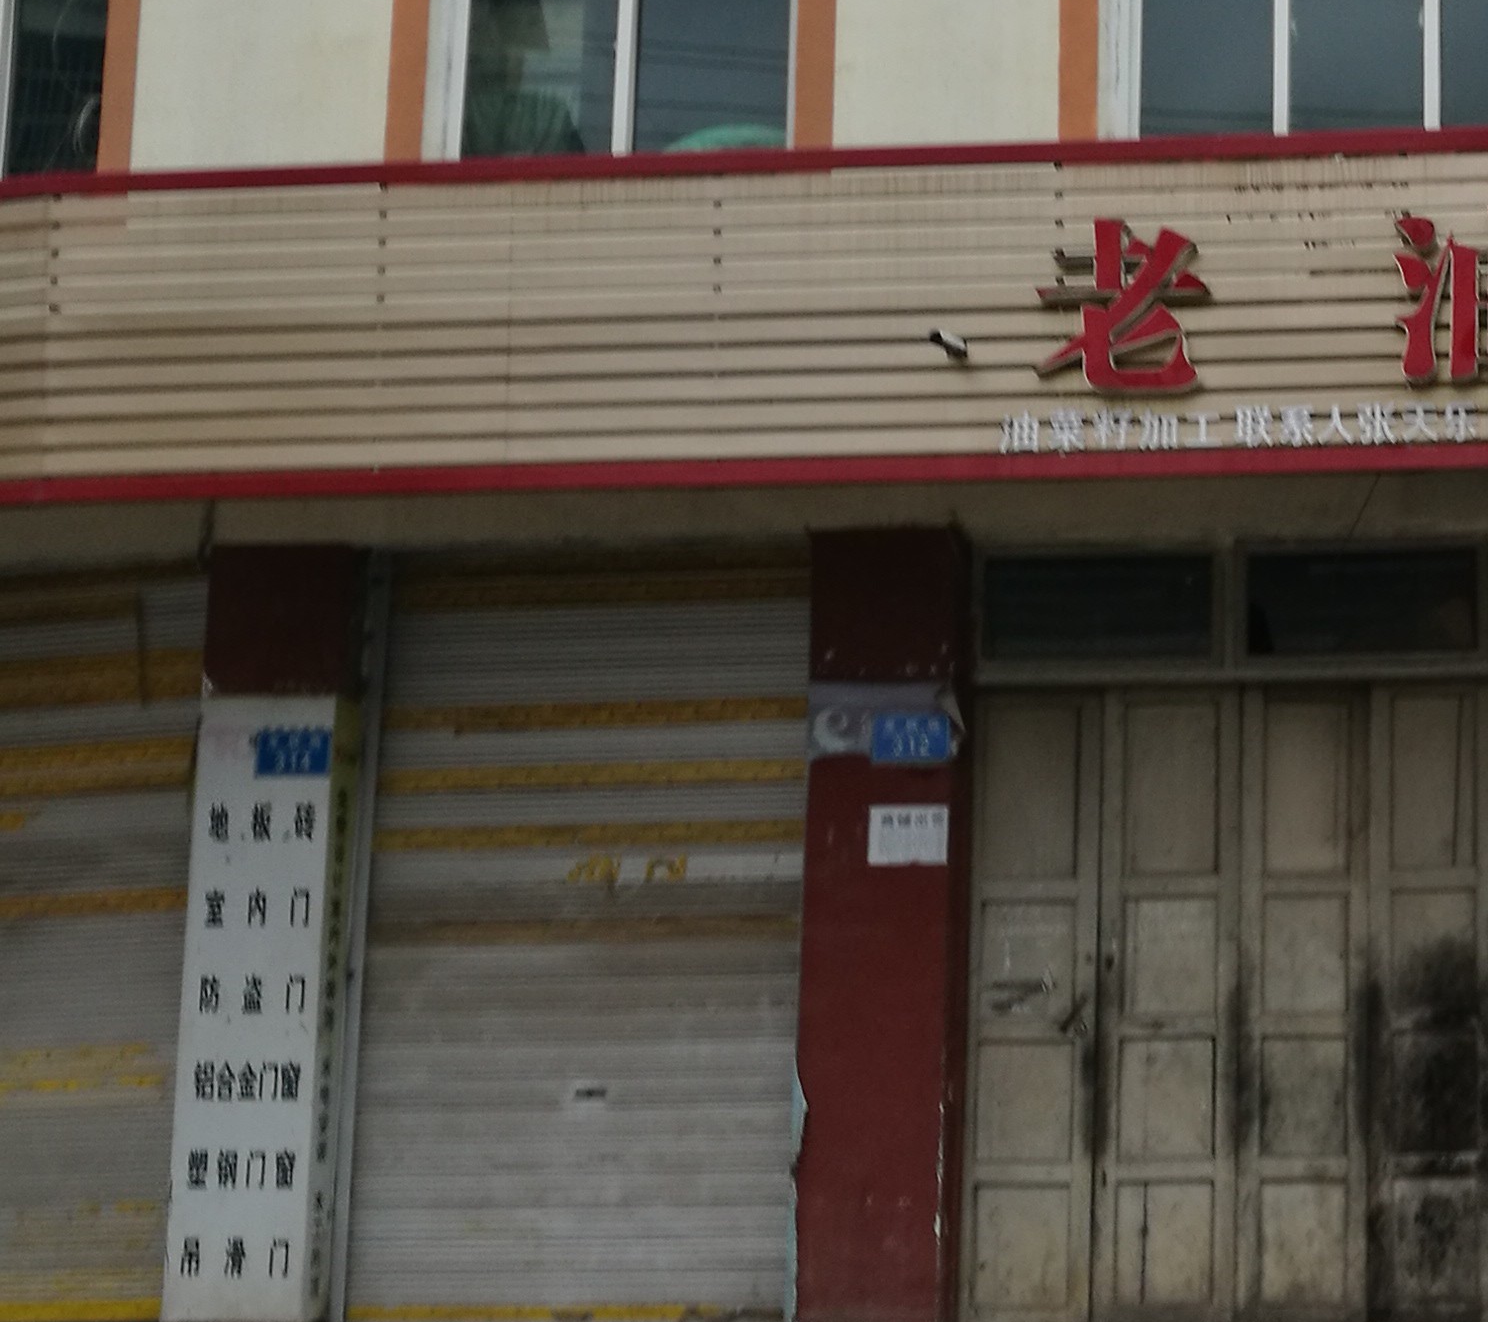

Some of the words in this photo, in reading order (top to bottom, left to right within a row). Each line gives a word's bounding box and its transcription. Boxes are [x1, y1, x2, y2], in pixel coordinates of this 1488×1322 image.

[1000, 407, 1222, 454] 油菜籽加工
[208, 801, 316, 843] 地板砖
[205, 886, 310, 928] 室内门
[199, 973, 306, 1015] 防盗门
[194, 1059, 301, 1103] 铝合金门窗
[187, 1148, 296, 1190] 塑钢门窗
[180, 1235, 289, 1279] 吊滑门
